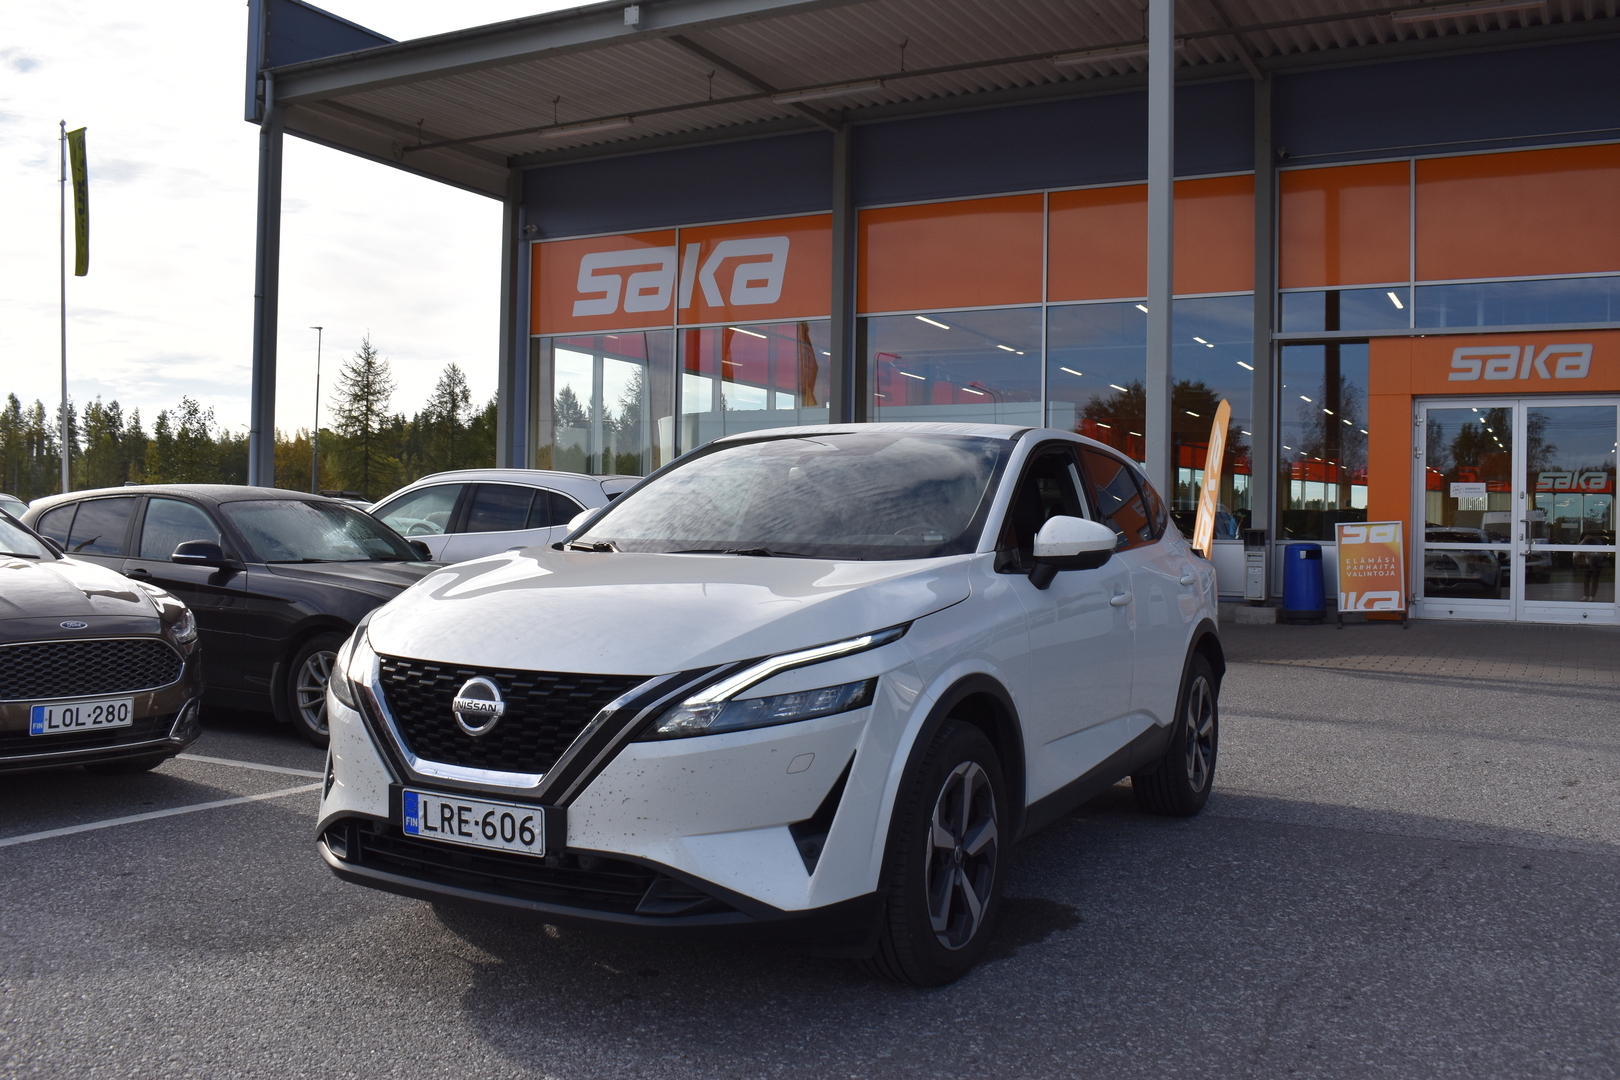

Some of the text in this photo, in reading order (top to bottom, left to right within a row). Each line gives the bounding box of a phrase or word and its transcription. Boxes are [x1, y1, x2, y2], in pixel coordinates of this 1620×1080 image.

[1345, 556, 1395, 564] ELÄMÄSI
[48, 703, 128, 729] LOL-280
[454, 700, 497, 713] NISSAN
[405, 800, 536, 846] FIN LRE-606
